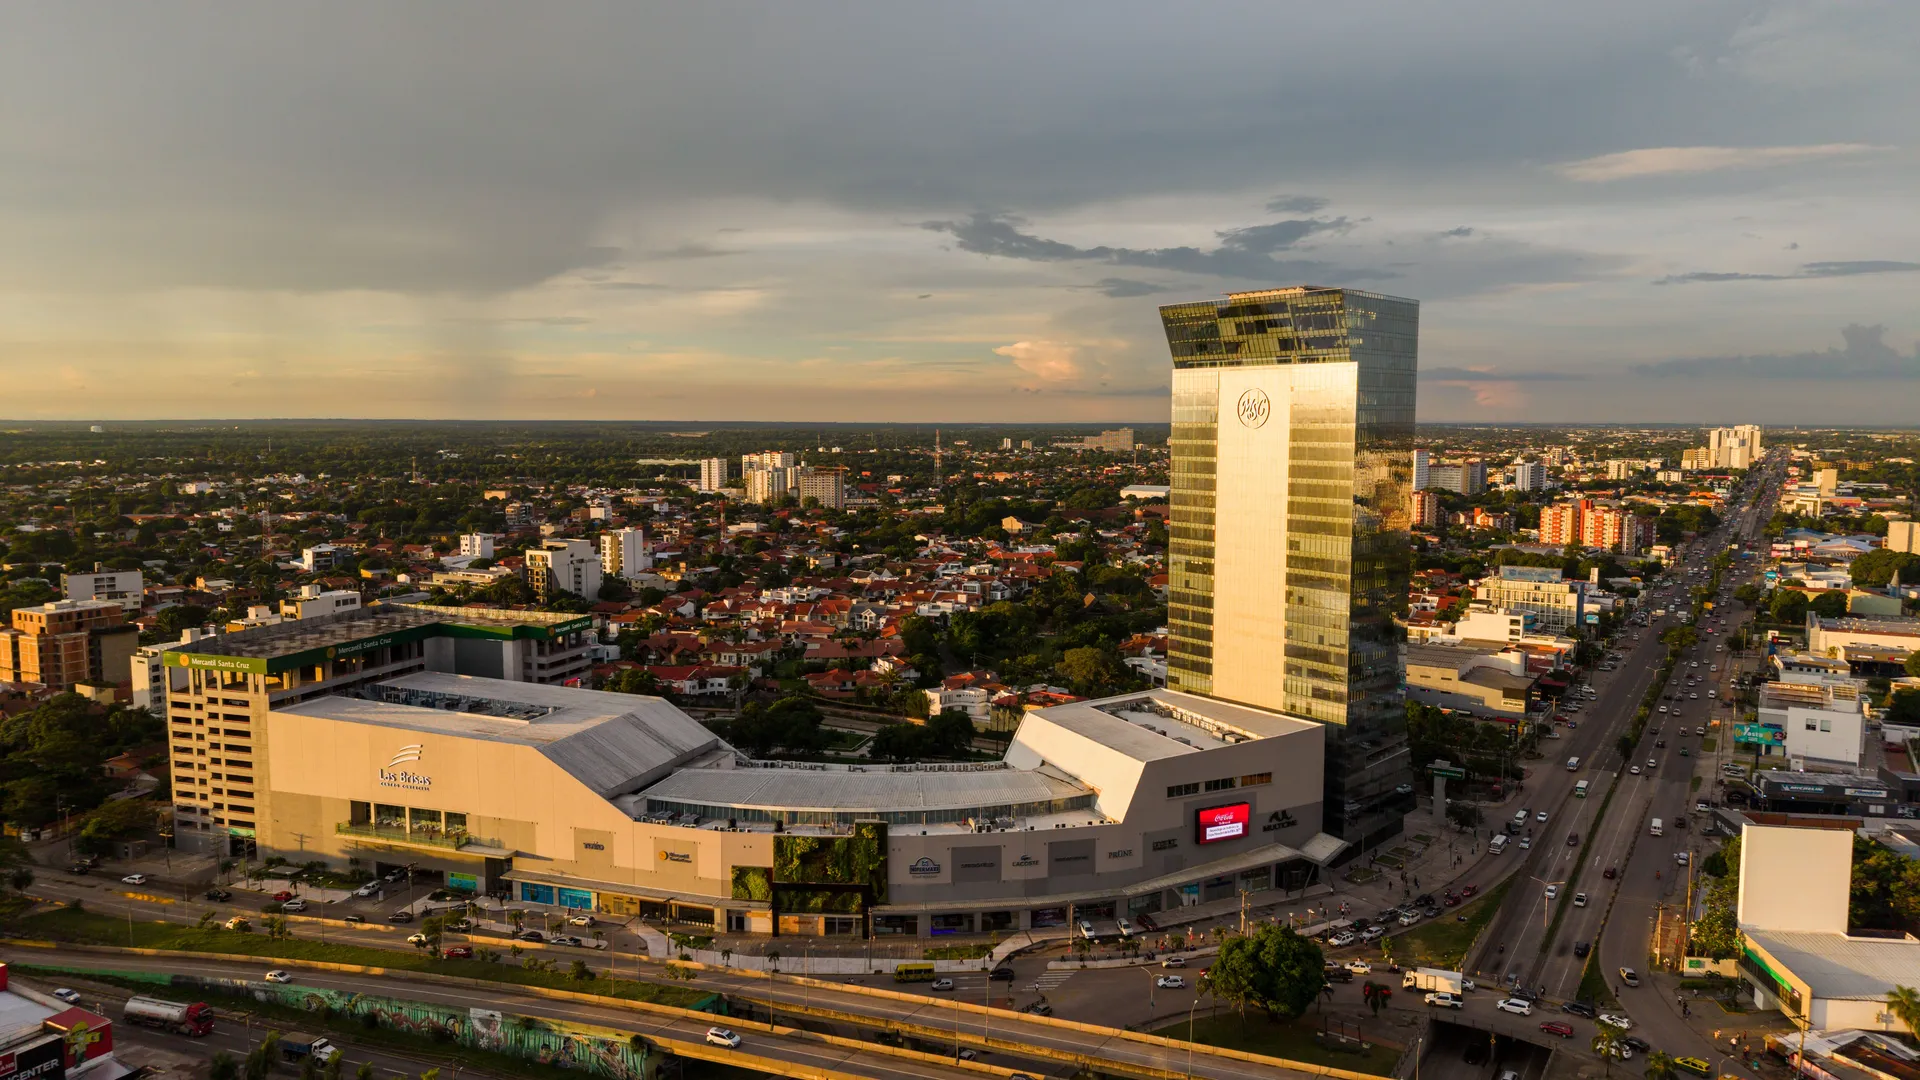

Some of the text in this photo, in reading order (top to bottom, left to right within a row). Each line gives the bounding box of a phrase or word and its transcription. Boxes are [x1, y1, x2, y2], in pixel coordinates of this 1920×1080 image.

[338, 643, 363, 654] Mercantil
[363, 641, 379, 649] Santa
[191, 658, 250, 669] Mercantil Santa Cruz
[379, 768, 432, 786] Las Brisas
